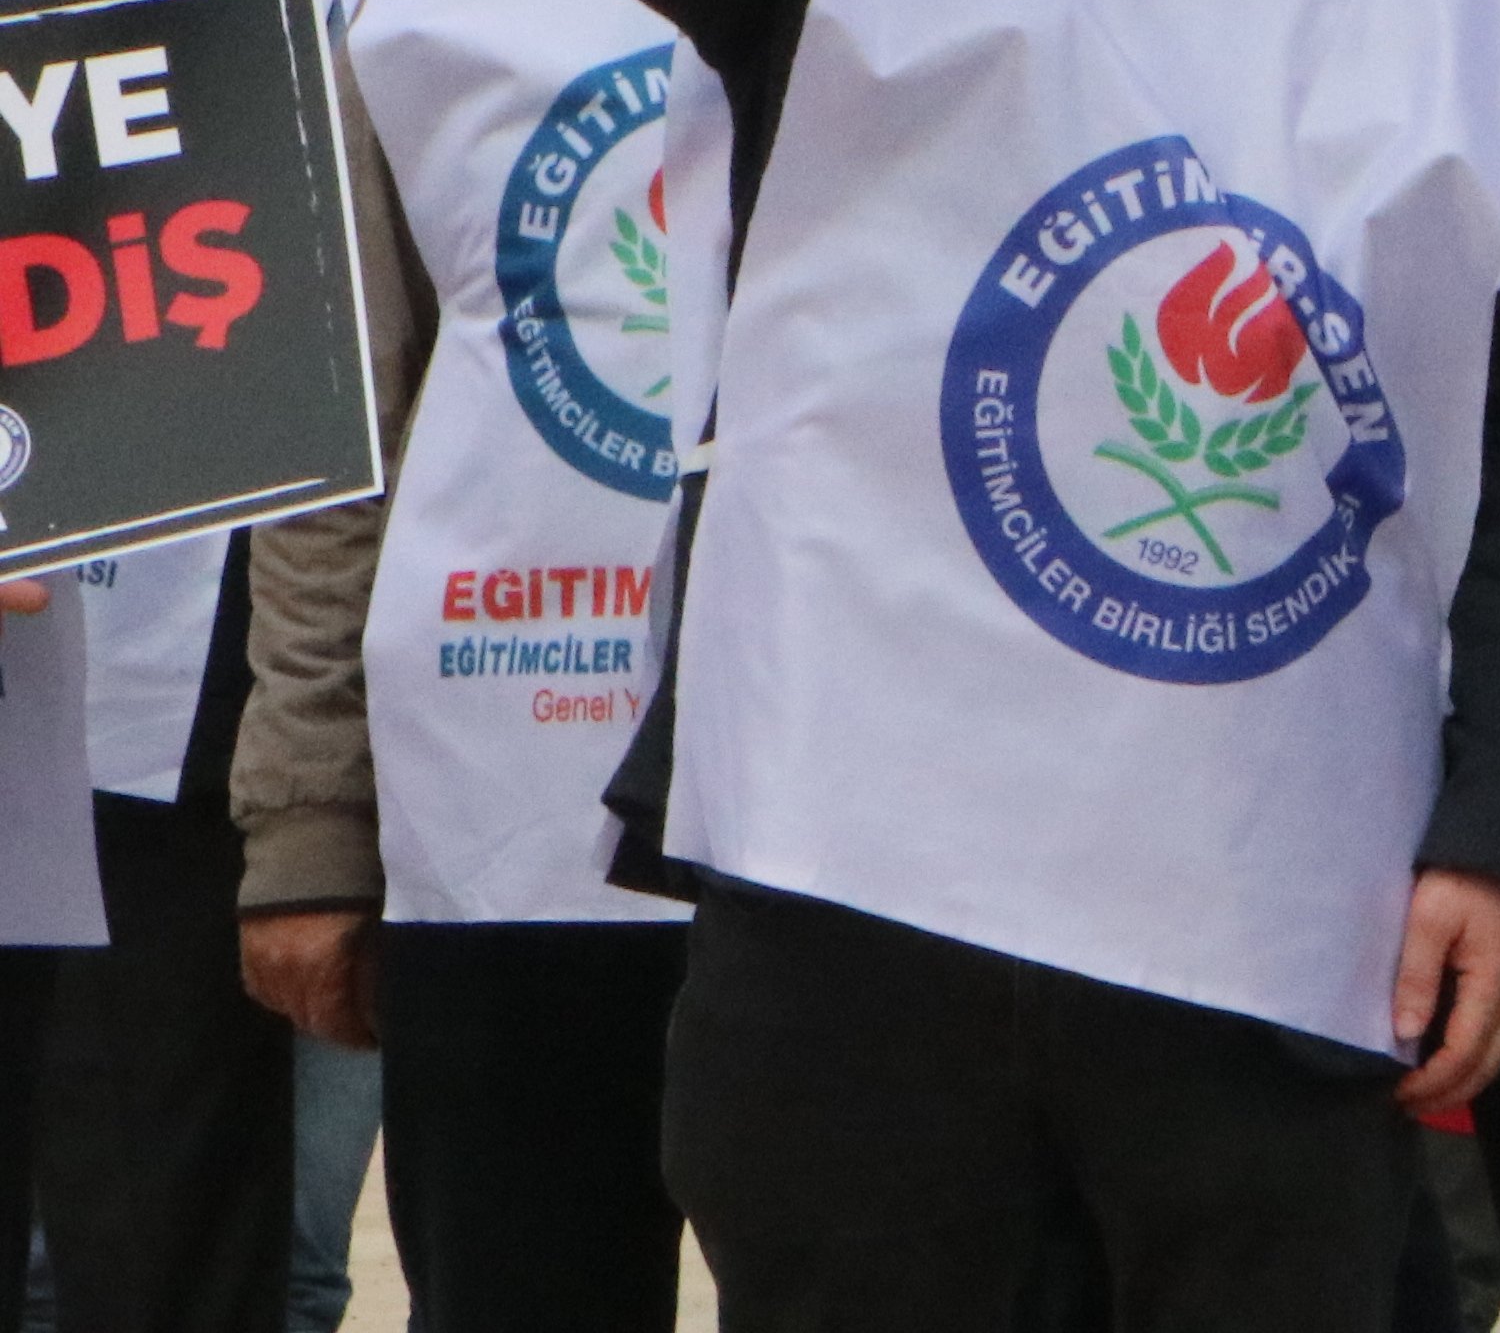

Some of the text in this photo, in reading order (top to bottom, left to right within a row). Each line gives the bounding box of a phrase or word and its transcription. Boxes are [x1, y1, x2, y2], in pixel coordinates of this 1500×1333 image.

[511, 294, 647, 476] EĞİTİMCİLER
[974, 367, 1362, 655] EĞİTİMCİLER BİRLİĞİ SENDİKSI
[1136, 535, 1201, 577] 1992
[438, 632, 632, 679] EĞİTİMCİLER
[531, 686, 614, 724] Genel
